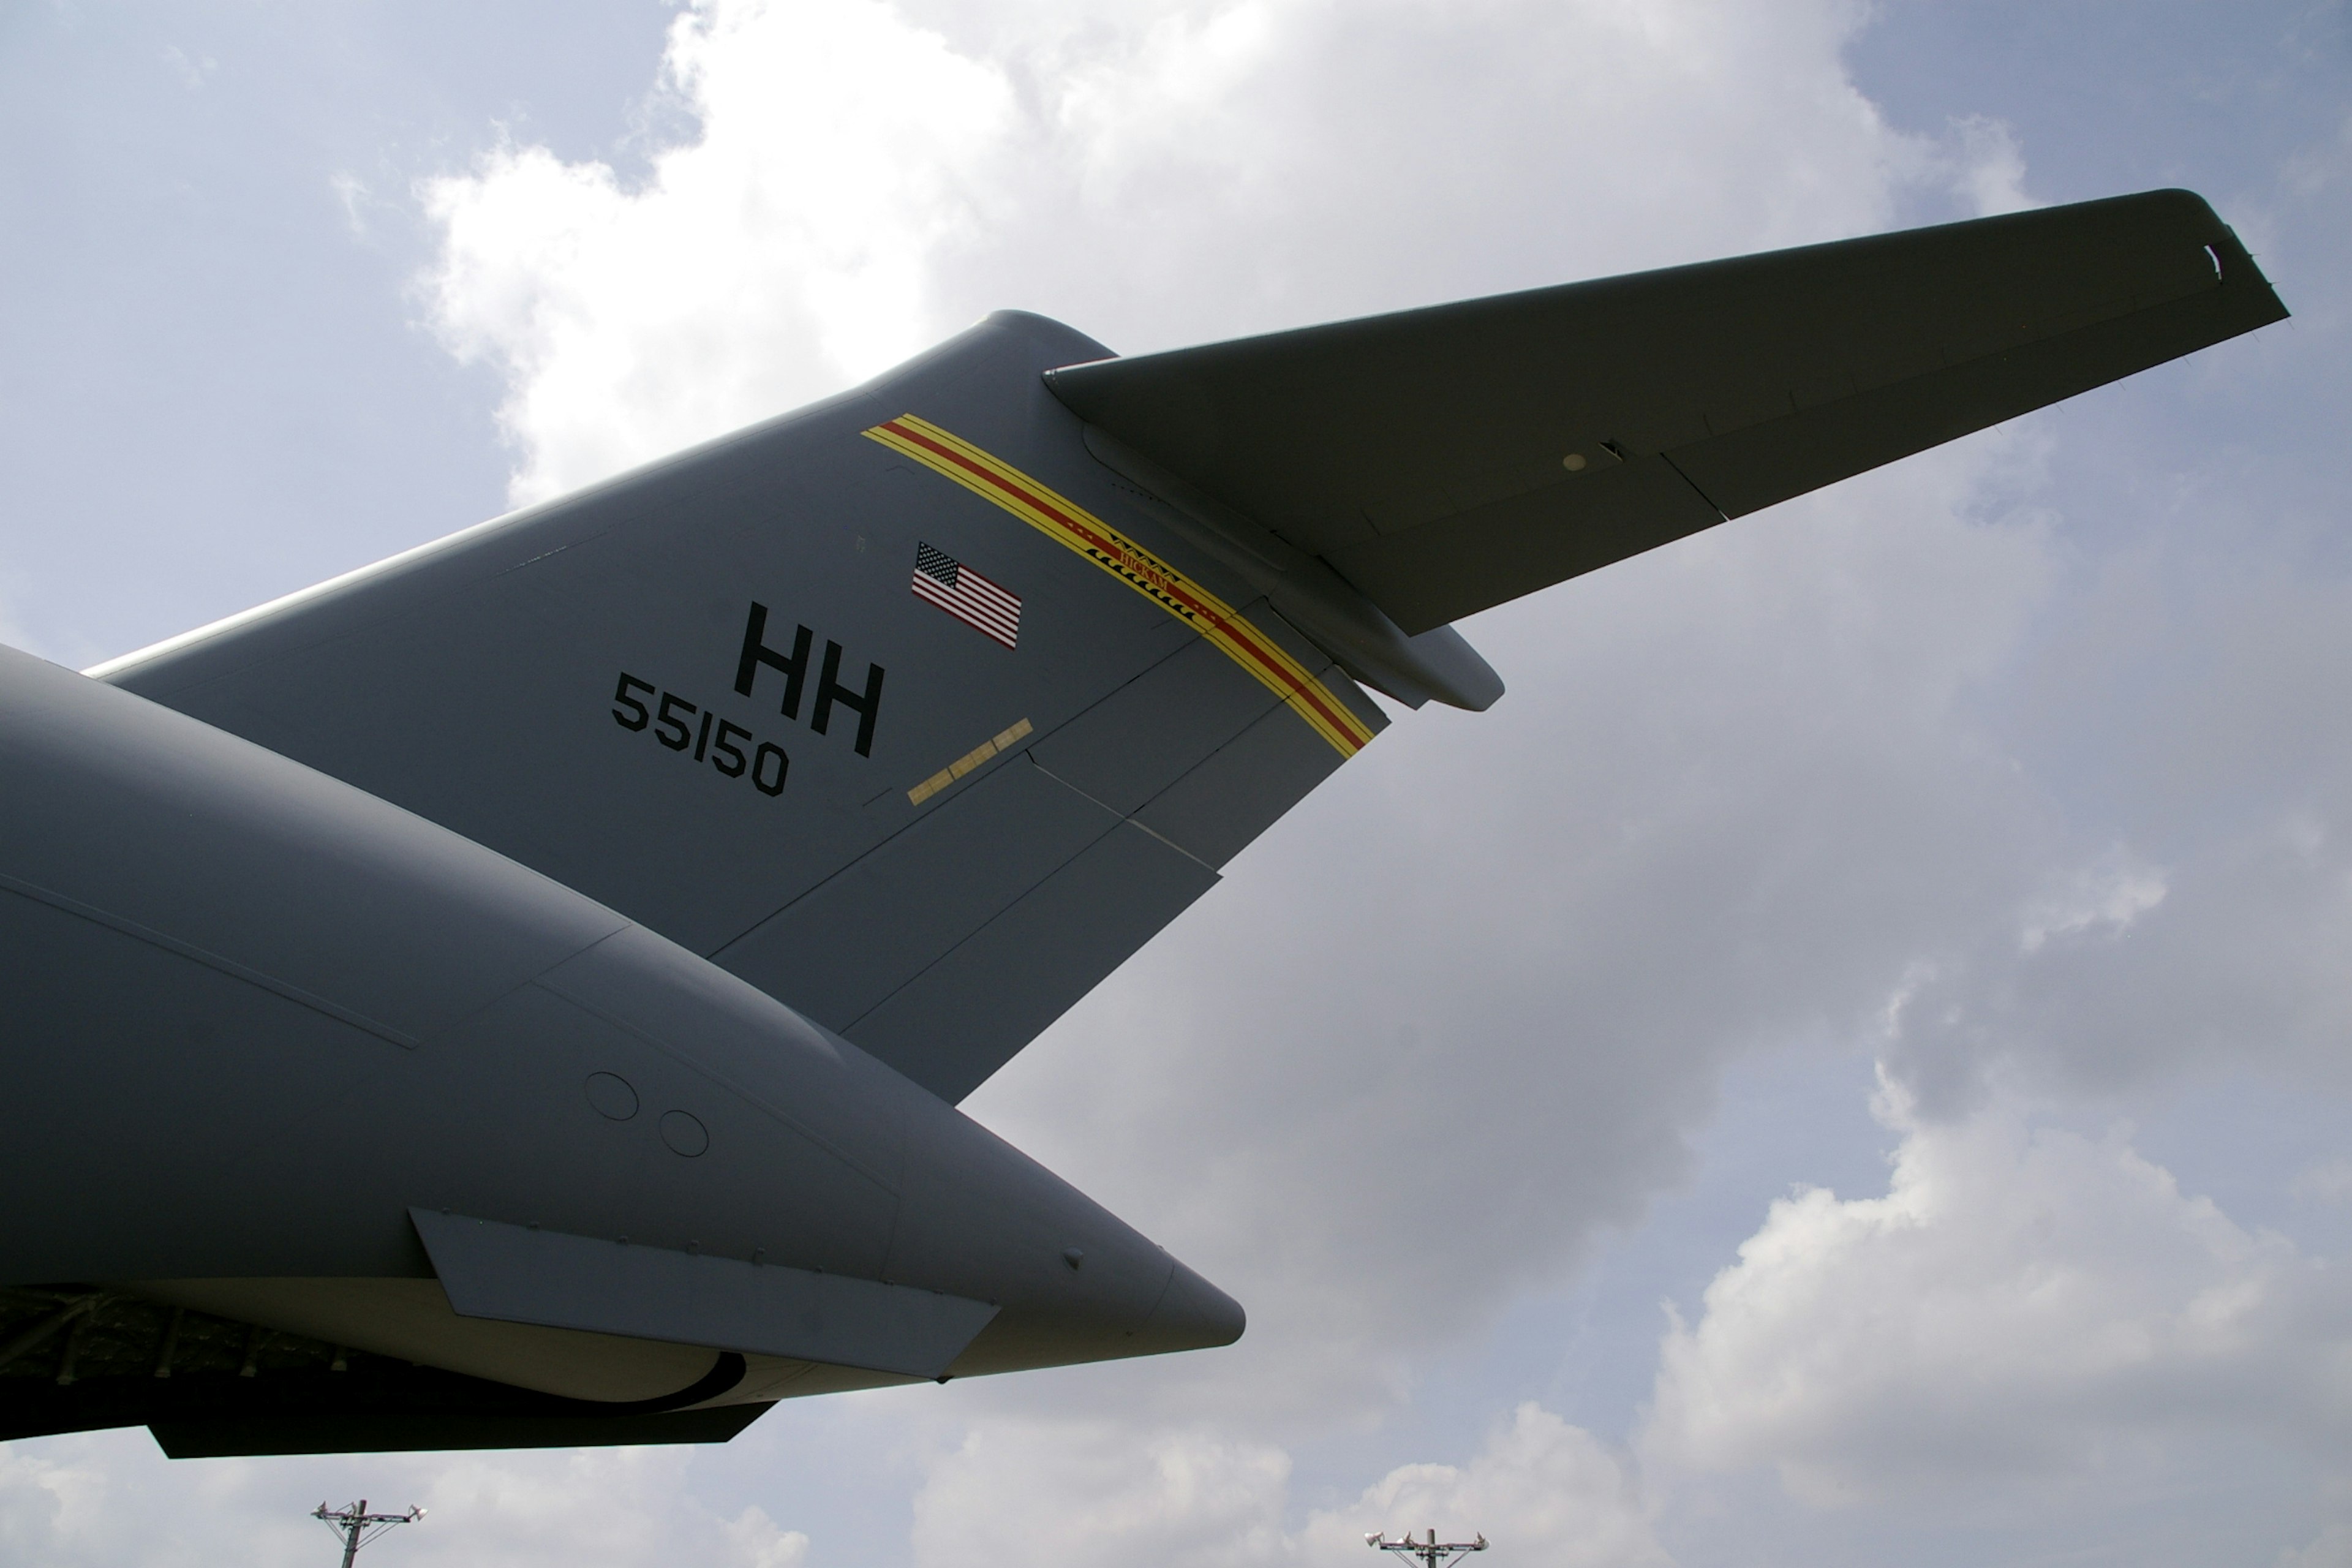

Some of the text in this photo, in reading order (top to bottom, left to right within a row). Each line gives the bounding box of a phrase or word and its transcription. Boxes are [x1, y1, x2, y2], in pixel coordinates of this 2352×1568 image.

[1120, 552, 1168, 590] HICKAM
[612, 672, 789, 797] 55150
[734, 601, 884, 758] HH
